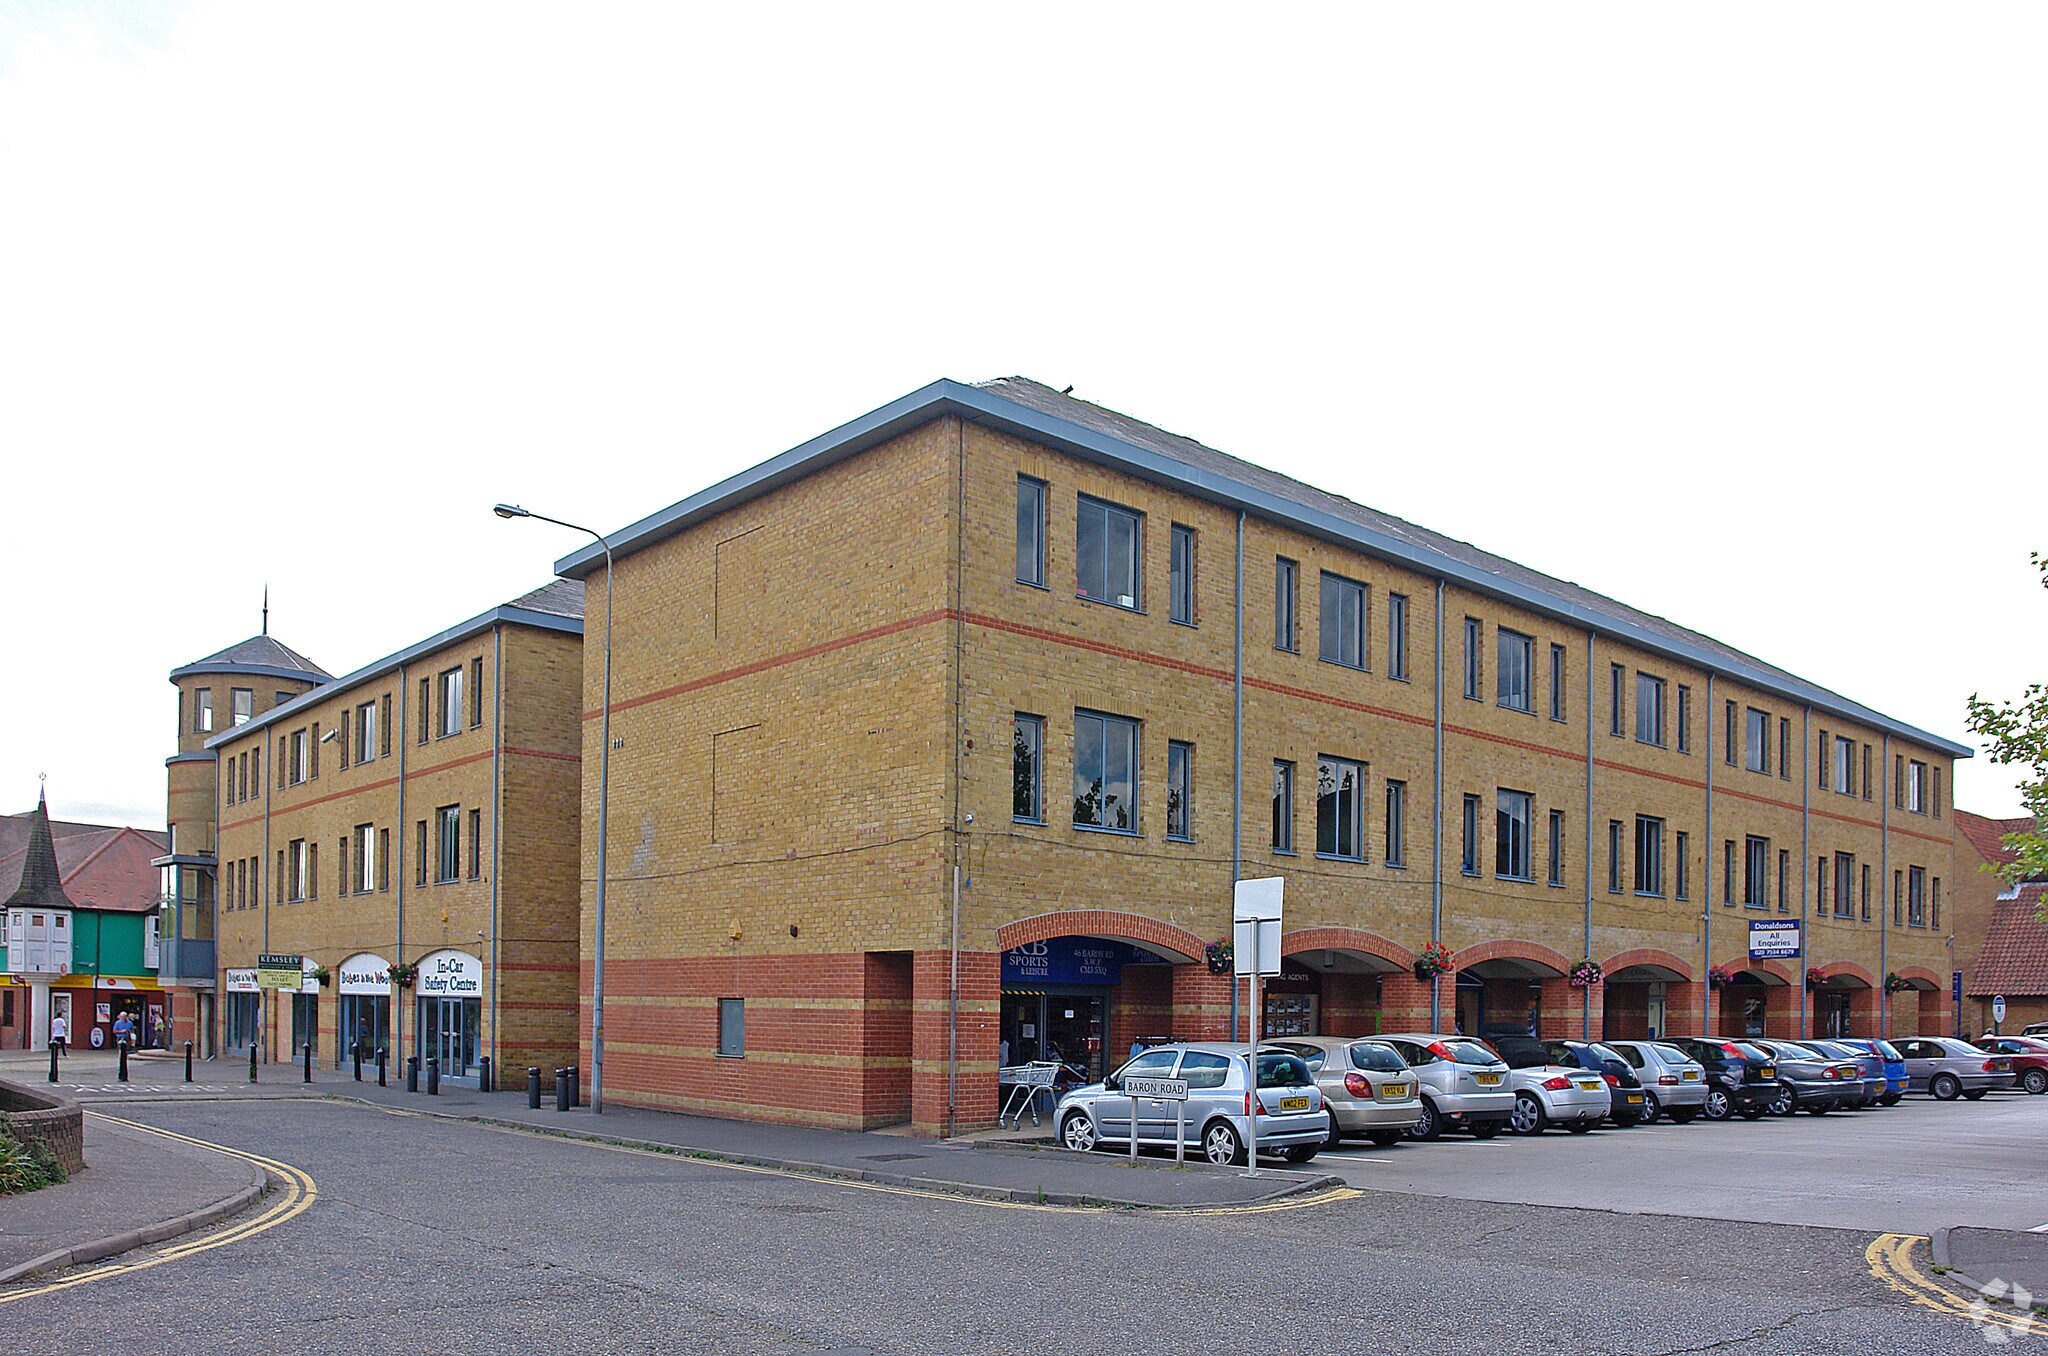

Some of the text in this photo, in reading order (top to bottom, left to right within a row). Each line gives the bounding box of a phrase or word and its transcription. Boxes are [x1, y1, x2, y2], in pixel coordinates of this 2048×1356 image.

[1758, 939, 1791, 947] Enquiries
[1082, 949, 1104, 958] BARON
[1105, 950, 1114, 959] RD
[260, 955, 299, 964] KEMSLEY
[1009, 955, 1049, 967] SPORTS
[437, 958, 463, 973] In-Car
[1080, 965, 1094, 974] CM3
[1025, 967, 1049, 976] LEISURE
[375, 971, 389, 985] Woo
[1287, 973, 1310, 981] AGENTS
[424, 975, 477, 994] Safety Centre
[1128, 1081, 1184, 1095] BARON ROAD
